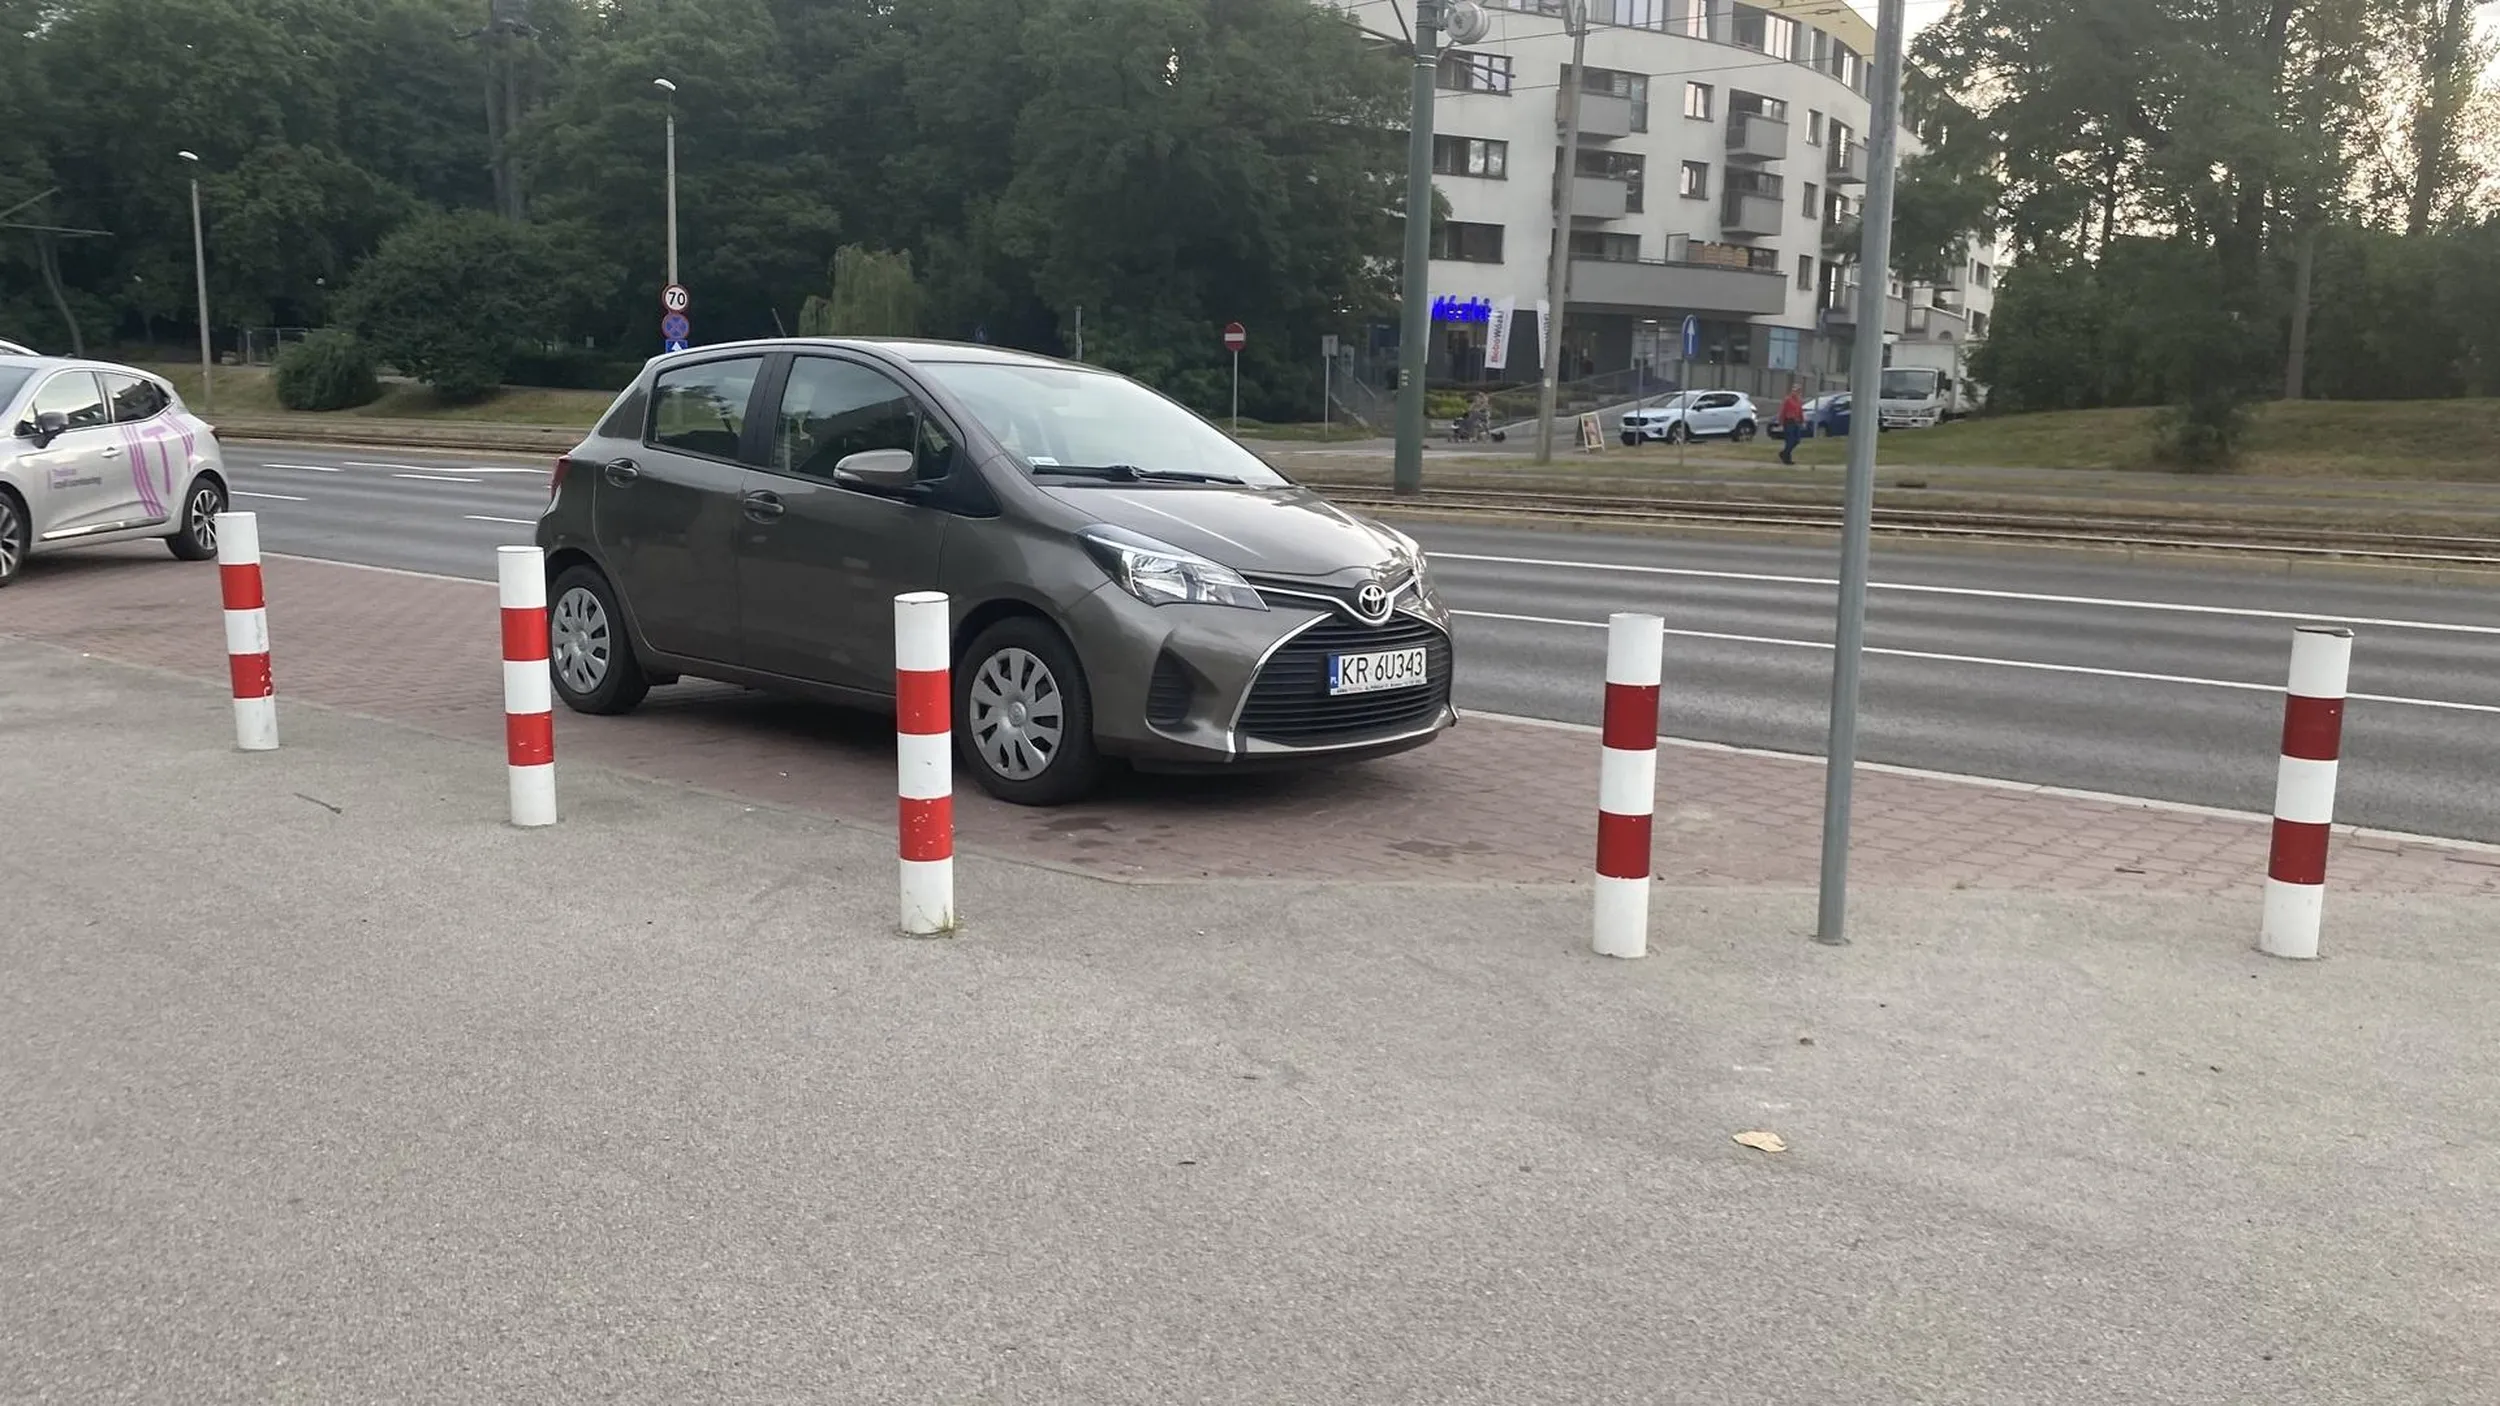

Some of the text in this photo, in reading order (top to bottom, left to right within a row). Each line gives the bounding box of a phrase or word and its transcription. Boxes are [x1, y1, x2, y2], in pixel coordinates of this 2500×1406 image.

[668, 291, 686, 306] 70
[1342, 651, 1423, 685] KR 6U343
